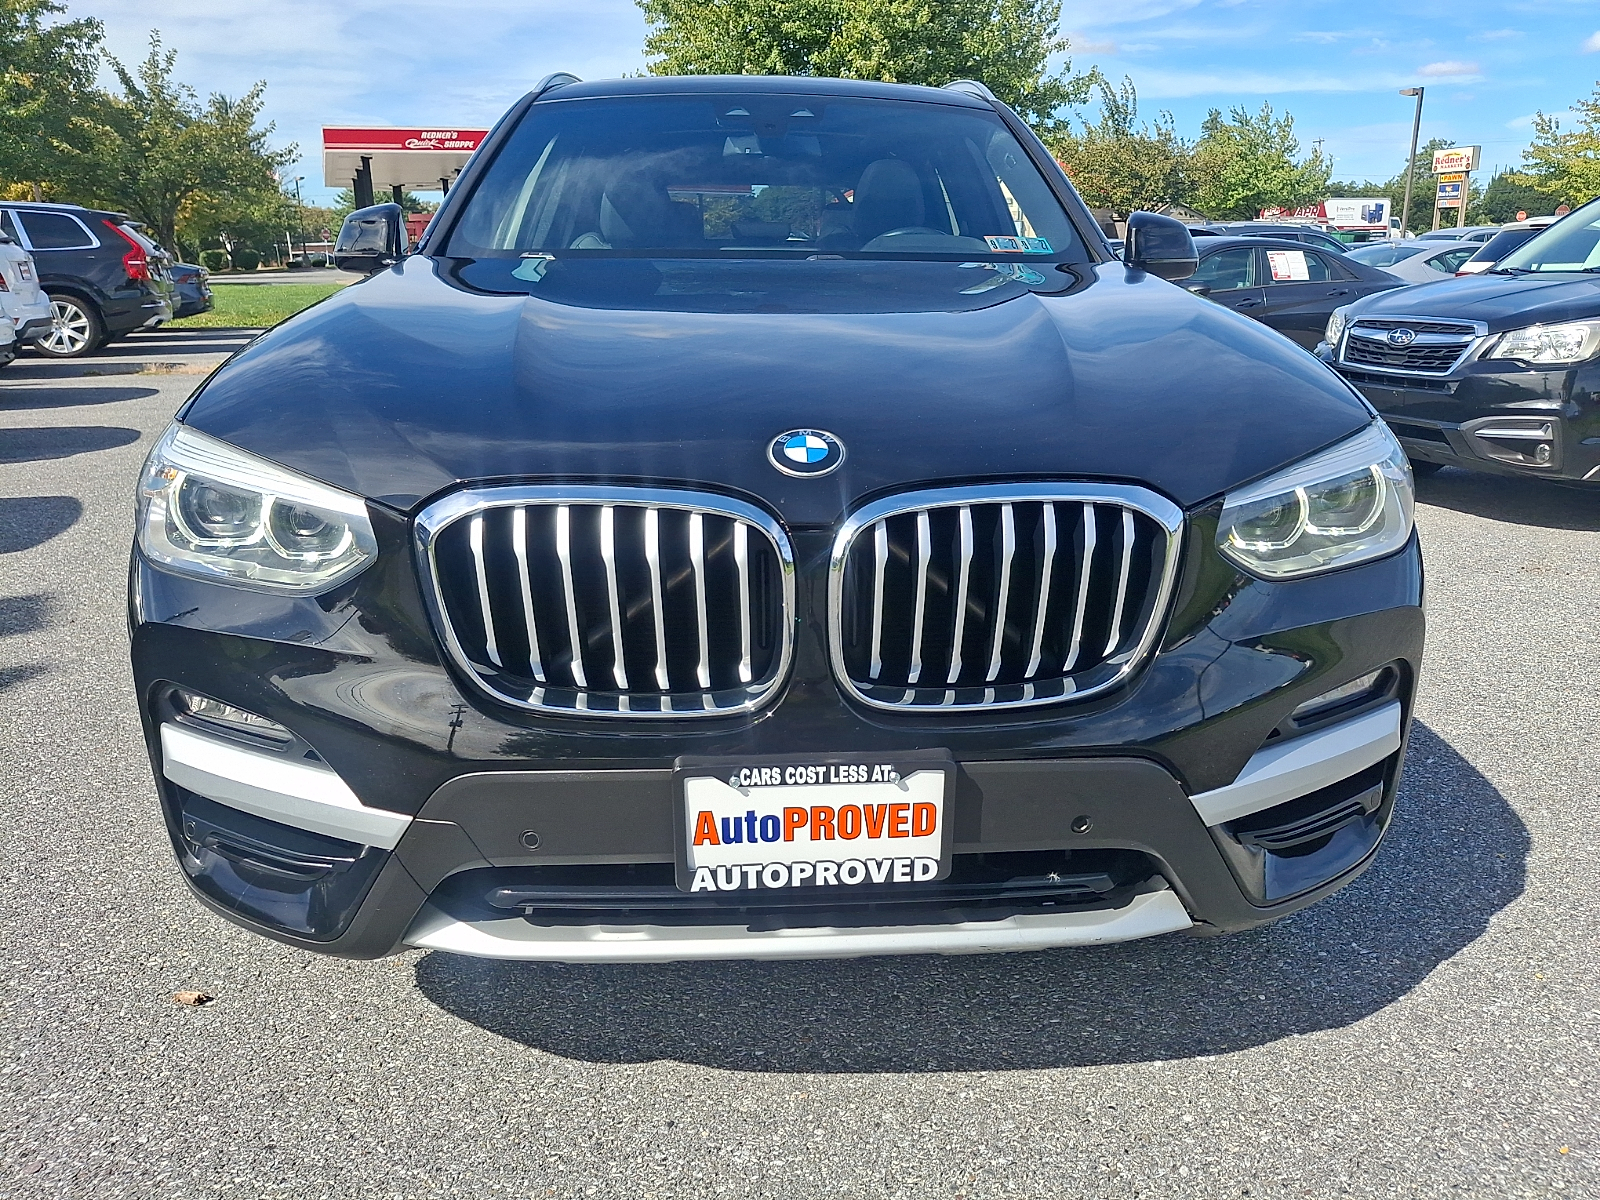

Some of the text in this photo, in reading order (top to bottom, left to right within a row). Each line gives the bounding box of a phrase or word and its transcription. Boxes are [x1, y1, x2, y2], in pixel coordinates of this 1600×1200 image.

[443, 140, 475, 148] SHOPPE
[1434, 154, 1470, 166] Redner's
[1443, 174, 1463, 182] PAWN
[778, 430, 835, 443] BMW
[740, 767, 782, 787] CARS
[785, 765, 827, 785] COST
[830, 764, 867, 783] LESS
[693, 802, 937, 846] AutoPROVED
[690, 857, 938, 893] AUTOPROVED
